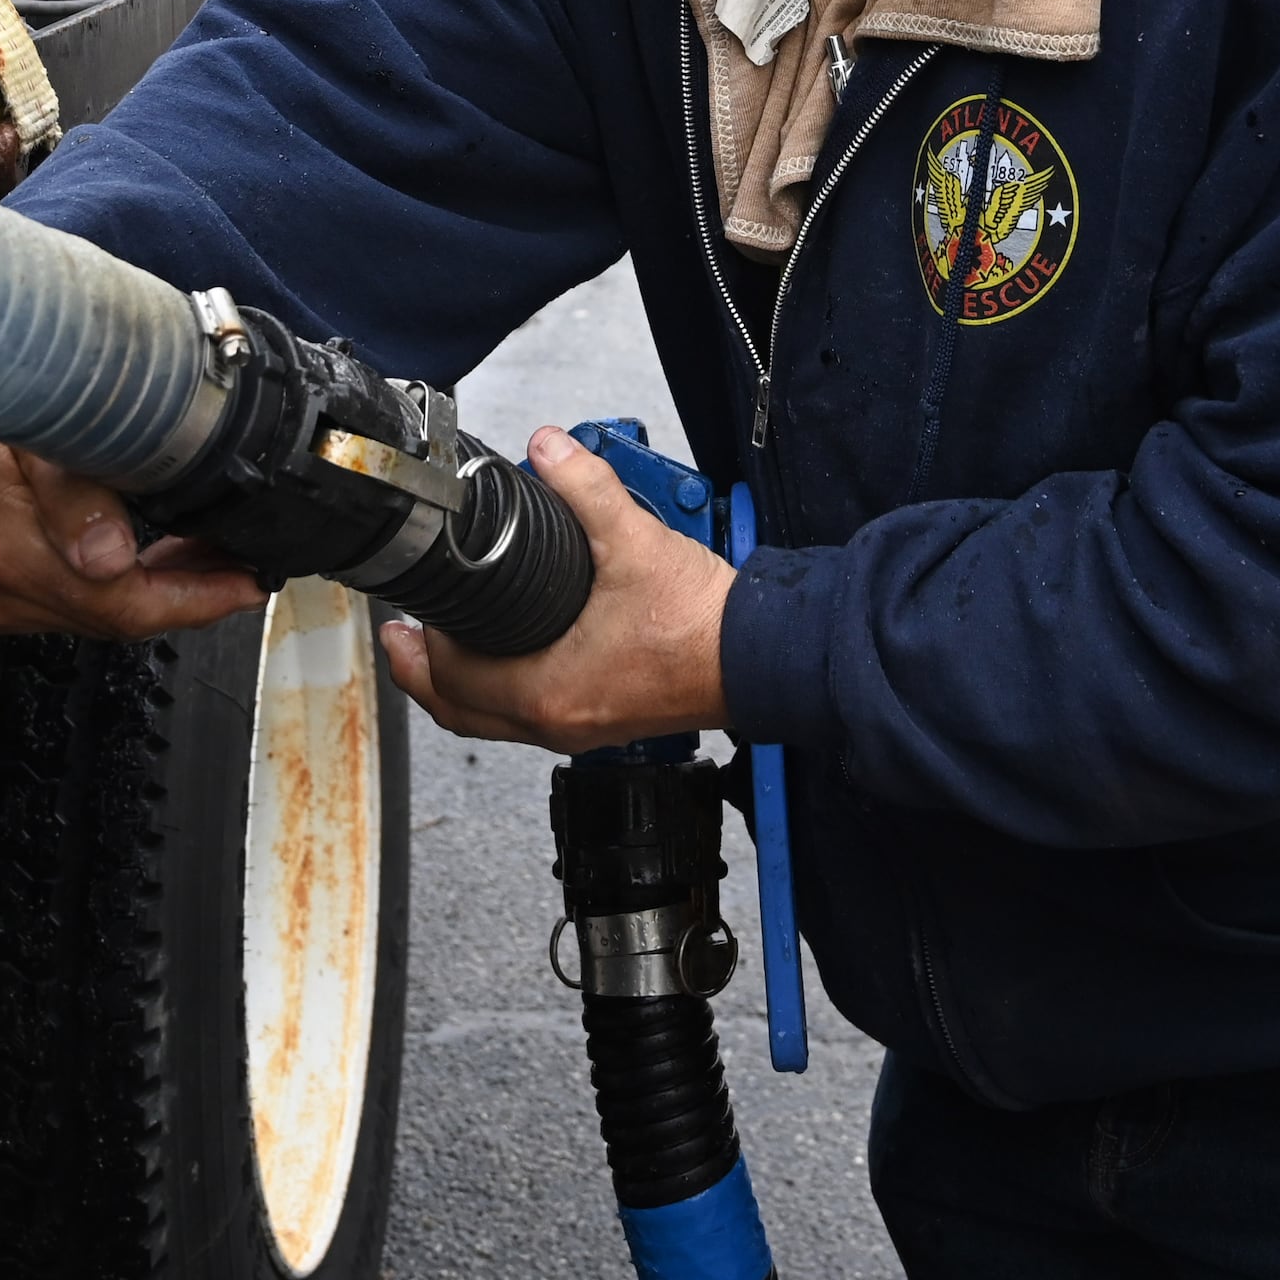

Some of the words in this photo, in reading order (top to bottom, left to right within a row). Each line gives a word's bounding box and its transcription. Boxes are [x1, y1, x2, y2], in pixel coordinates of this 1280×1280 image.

[942, 155, 964, 174] EST.
[991, 164, 1026, 183] 1882
[962, 252, 1057, 318] ESCUE
